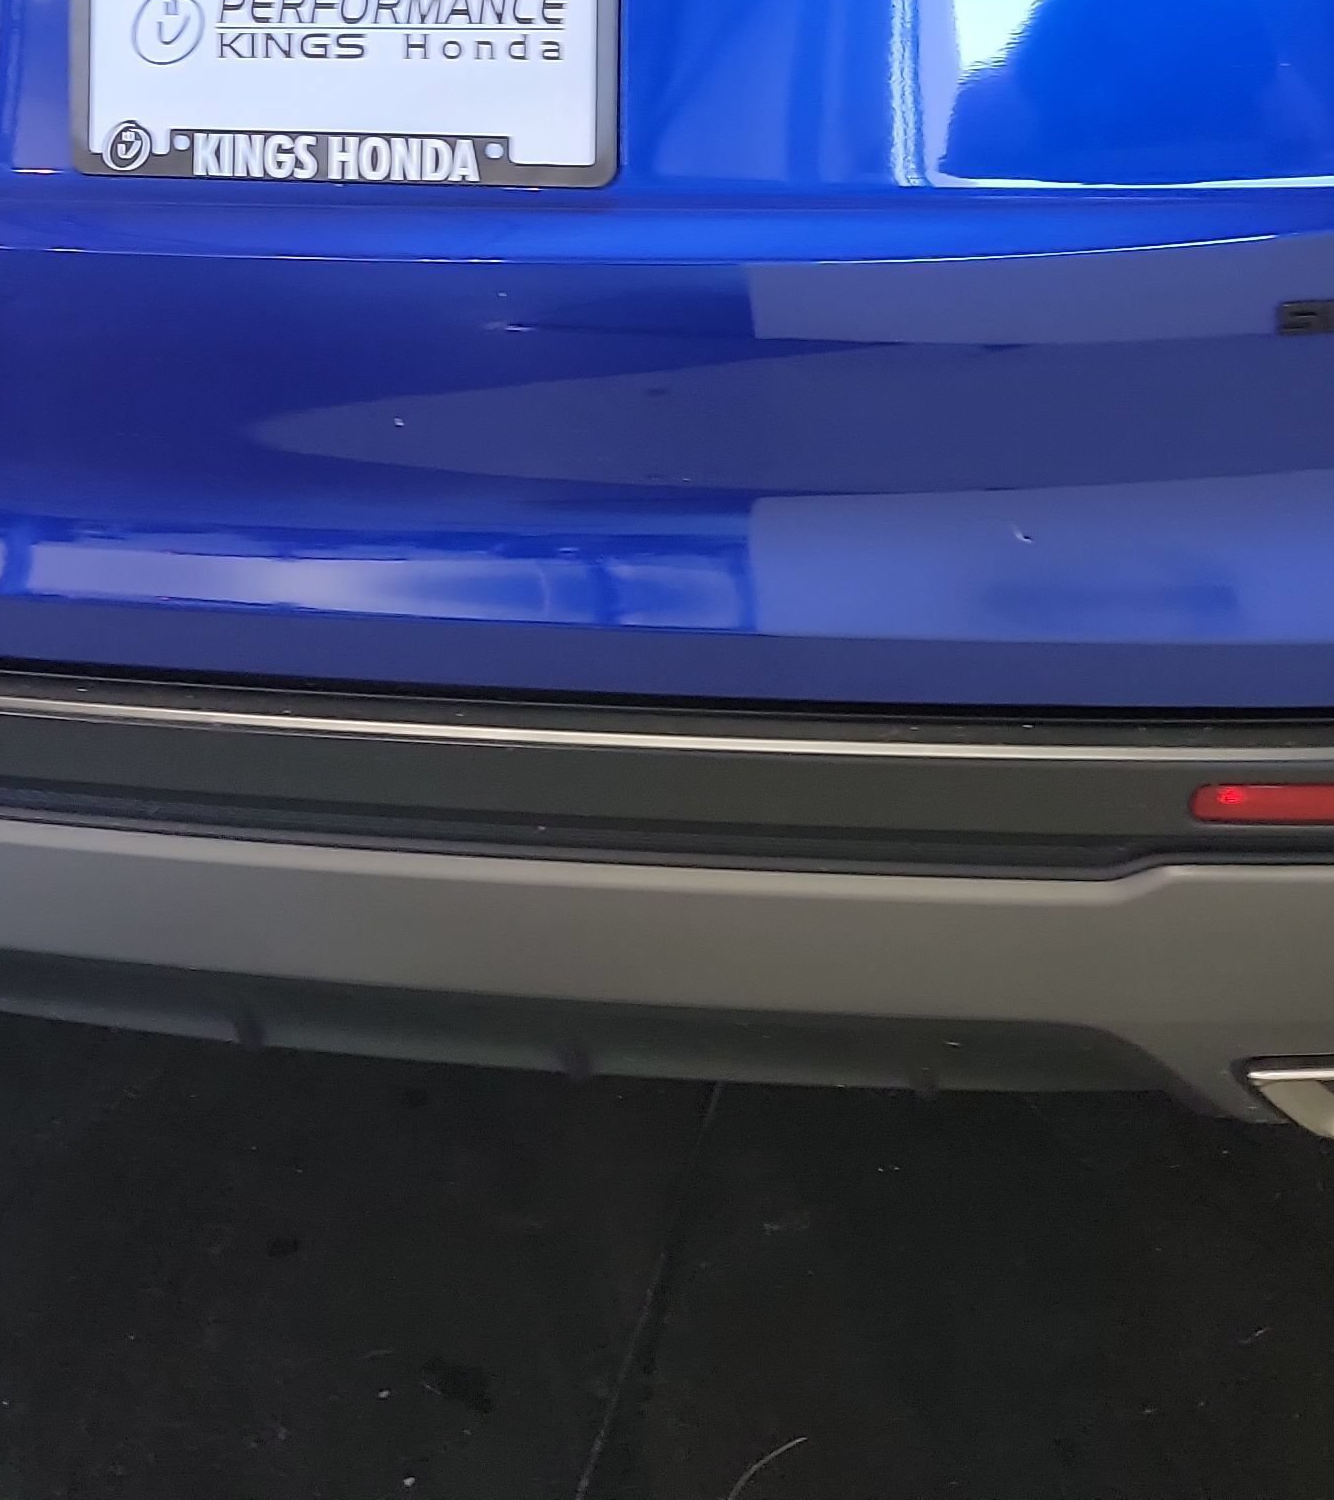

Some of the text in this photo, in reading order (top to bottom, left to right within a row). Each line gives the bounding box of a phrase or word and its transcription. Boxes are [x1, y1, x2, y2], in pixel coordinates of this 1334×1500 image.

[217, 32, 565, 61] KINGS Honda
[192, 133, 480, 182] KINGS HONDA
